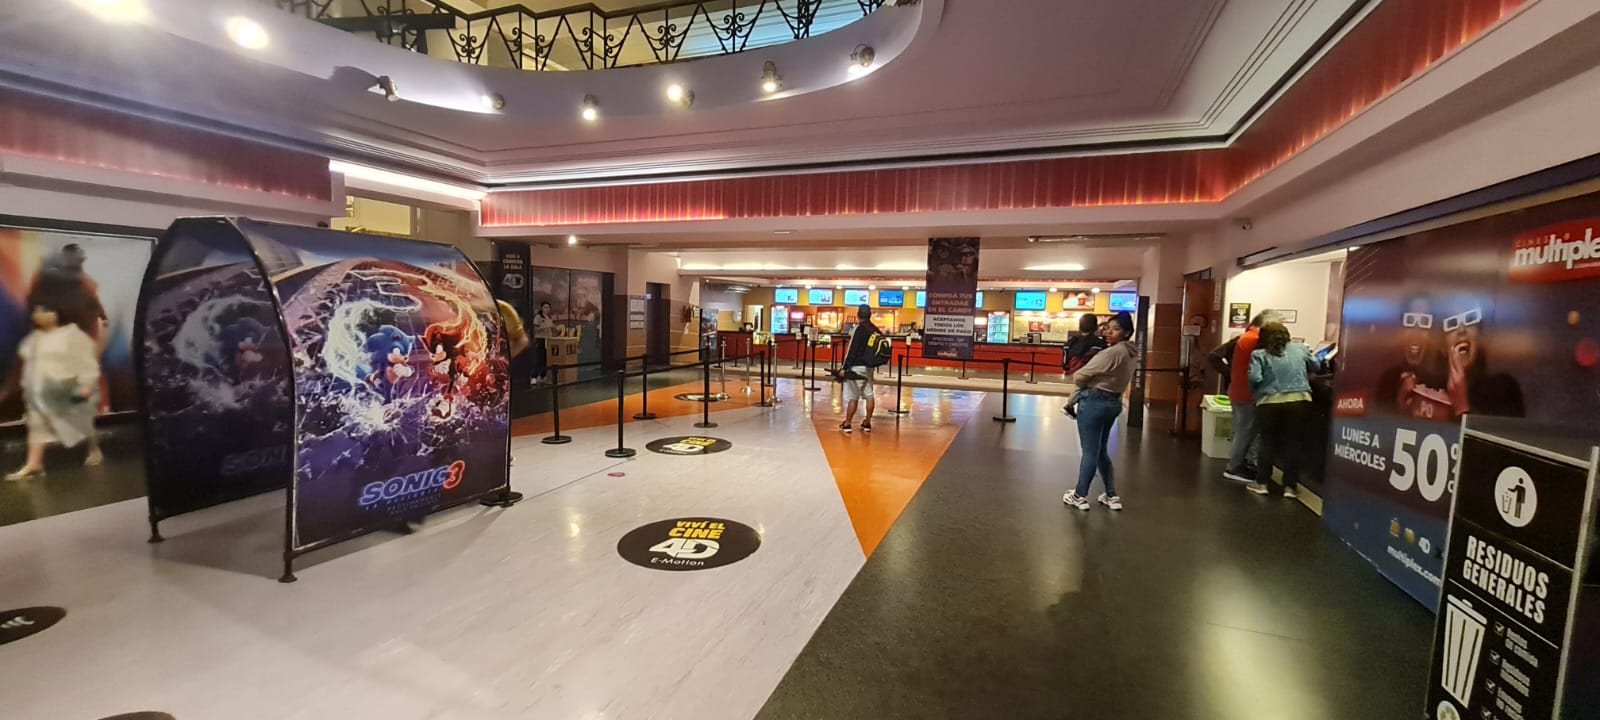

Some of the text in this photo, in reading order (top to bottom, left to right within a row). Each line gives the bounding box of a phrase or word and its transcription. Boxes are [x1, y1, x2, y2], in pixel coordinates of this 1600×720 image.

[502, 273, 524, 289] 4D
[1336, 397, 1364, 410] AHORA
[1341, 426, 1380, 449] LUNES A
[661, 442, 705, 453] 4D
[1334, 442, 1387, 472] MIÉRCOLES
[358, 465, 451, 506] SONIC
[442, 459, 467, 490] 3
[667, 527, 725, 540] CINE
[675, 520, 708, 529] VIVÍ
[648, 537, 720, 560] 4D
[650, 557, 705, 567] E-Motion
[1466, 535, 1549, 600] RESIDUOS
[1462, 558, 1546, 625] GENERALES
